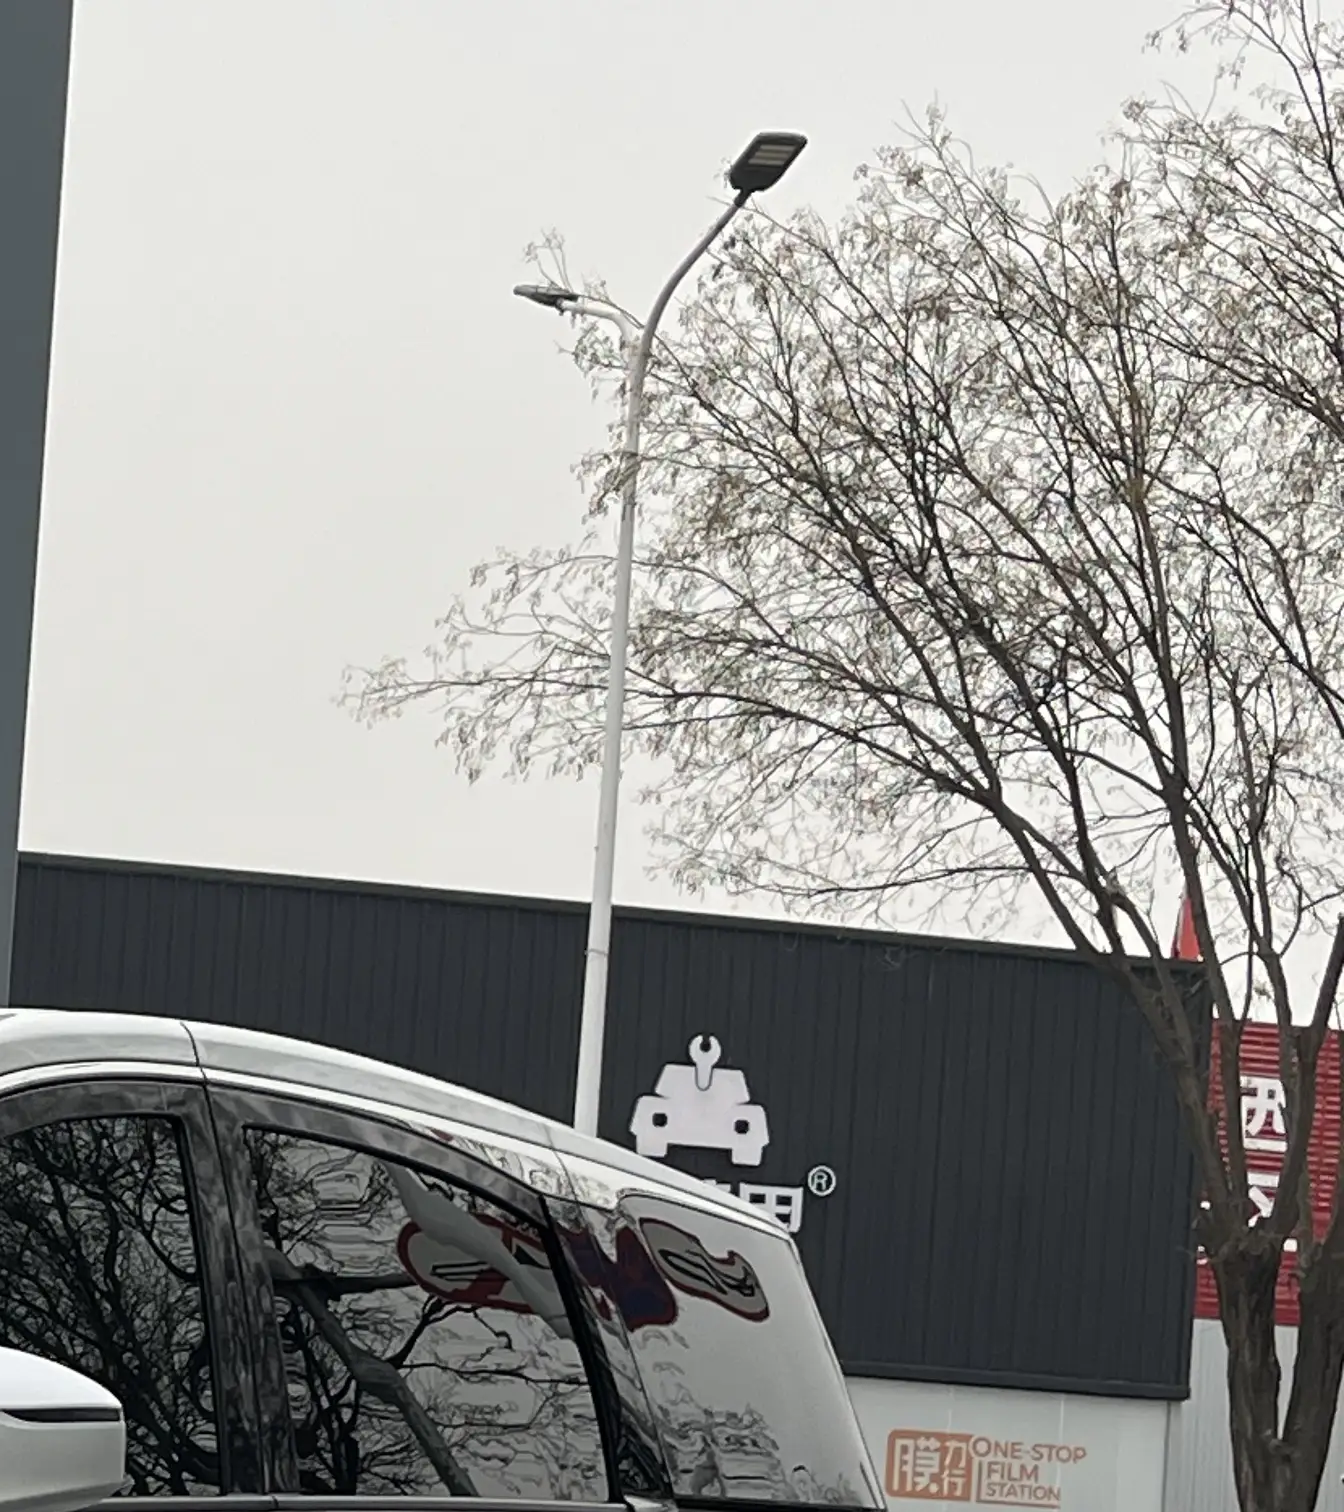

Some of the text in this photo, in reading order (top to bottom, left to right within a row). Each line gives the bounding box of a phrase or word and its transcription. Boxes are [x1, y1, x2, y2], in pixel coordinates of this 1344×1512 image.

[971, 1435, 1087, 1465] ONE-STOP
[986, 1460, 1039, 1484] FILM
[985, 1483, 1061, 1502] STATION
